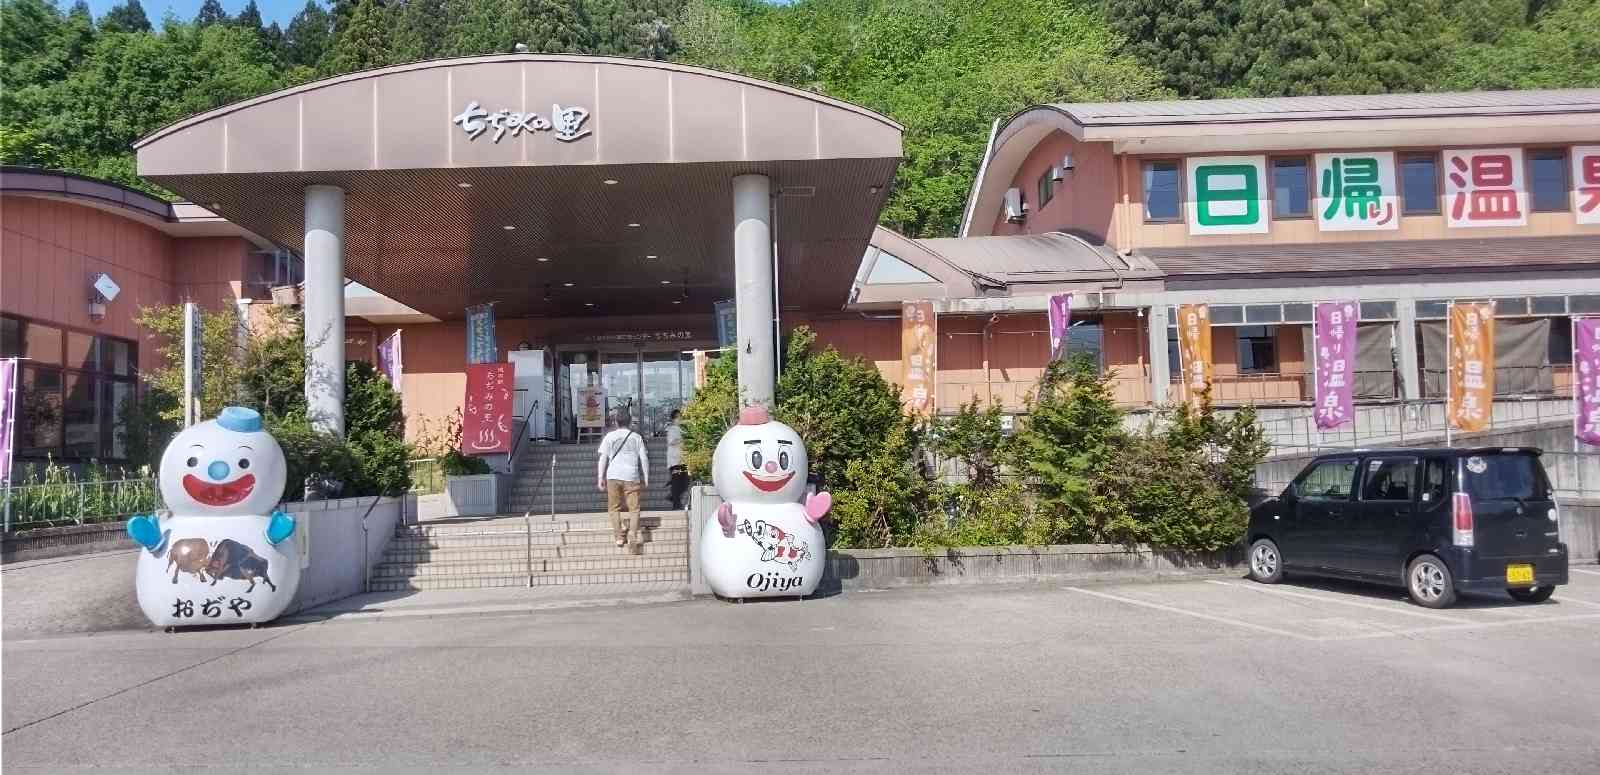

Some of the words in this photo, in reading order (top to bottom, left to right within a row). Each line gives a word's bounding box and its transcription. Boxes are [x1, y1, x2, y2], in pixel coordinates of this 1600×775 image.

[453, 102, 592, 144] ちぢみの里
[1320, 311, 1345, 420] 日帰り温泉
[746, 572, 804, 591] Ojiya
[172, 596, 252, 618] おぢや
